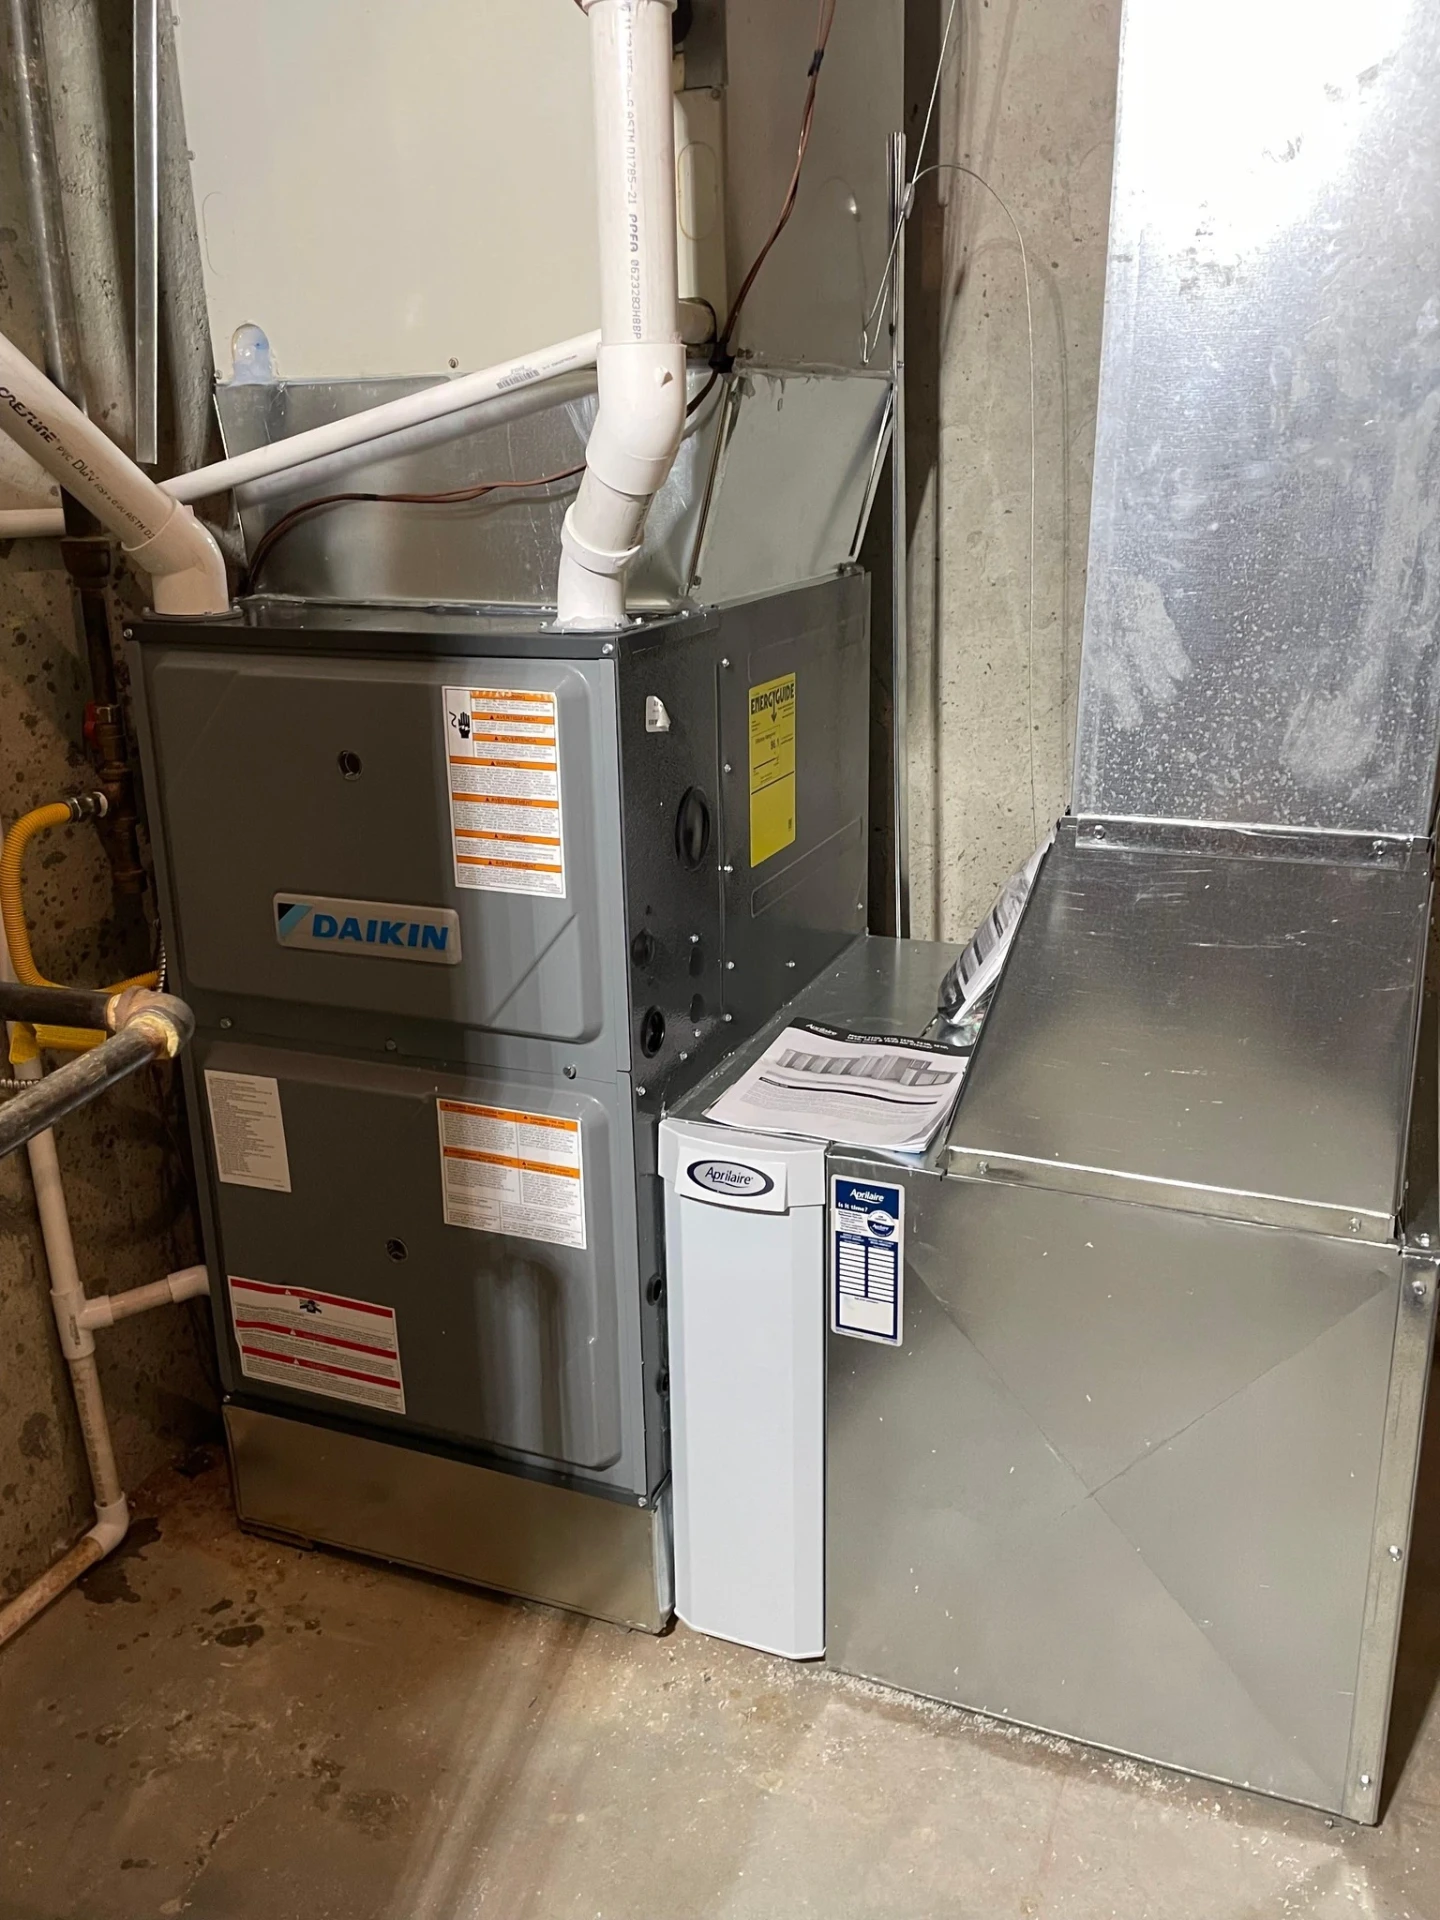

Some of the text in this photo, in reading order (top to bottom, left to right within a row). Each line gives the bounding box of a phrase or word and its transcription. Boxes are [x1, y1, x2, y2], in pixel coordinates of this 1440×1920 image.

[629, 214, 639, 253] PPFA
[56, 445, 74, 462] PVC
[125, 512, 147, 531] ASTM
[312, 913, 449, 951] DAIKIN
[705, 1166, 752, 1186] Aprilaire
[850, 1188, 884, 1203] Aprilaire
